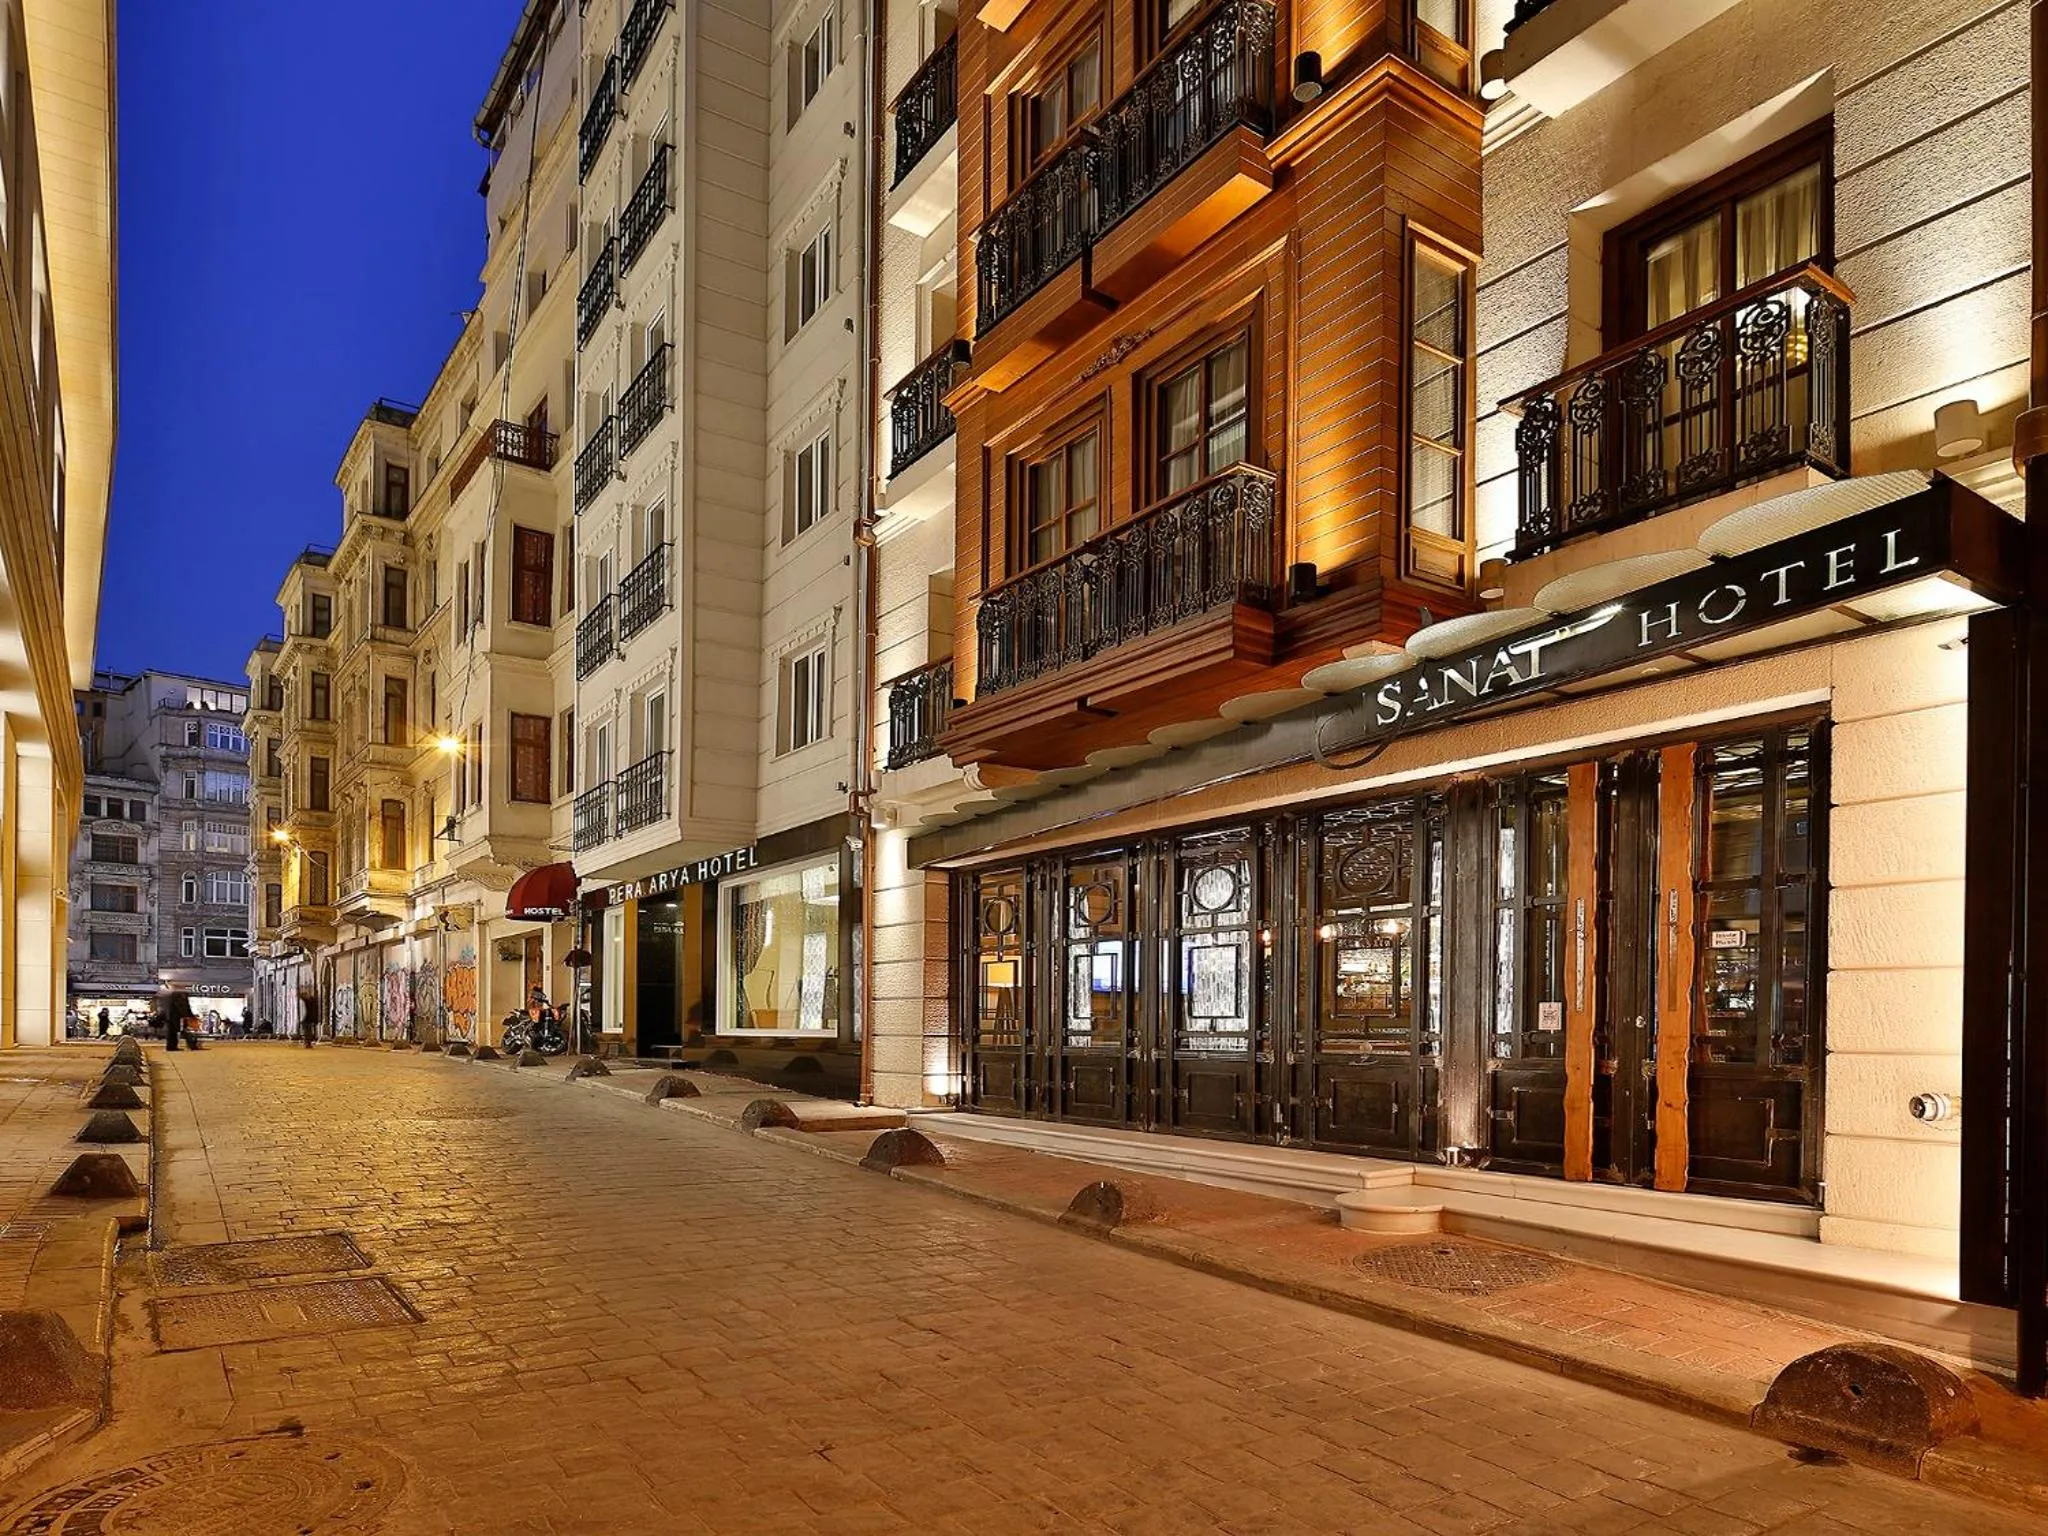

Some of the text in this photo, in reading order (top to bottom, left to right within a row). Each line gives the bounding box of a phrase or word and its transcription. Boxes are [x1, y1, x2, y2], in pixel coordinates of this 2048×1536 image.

[1376, 529, 1920, 725] SANAT HOTEL
[608, 847, 759, 905] PERA ARYA HOTEL
[523, 907, 565, 916] HOSTEL
